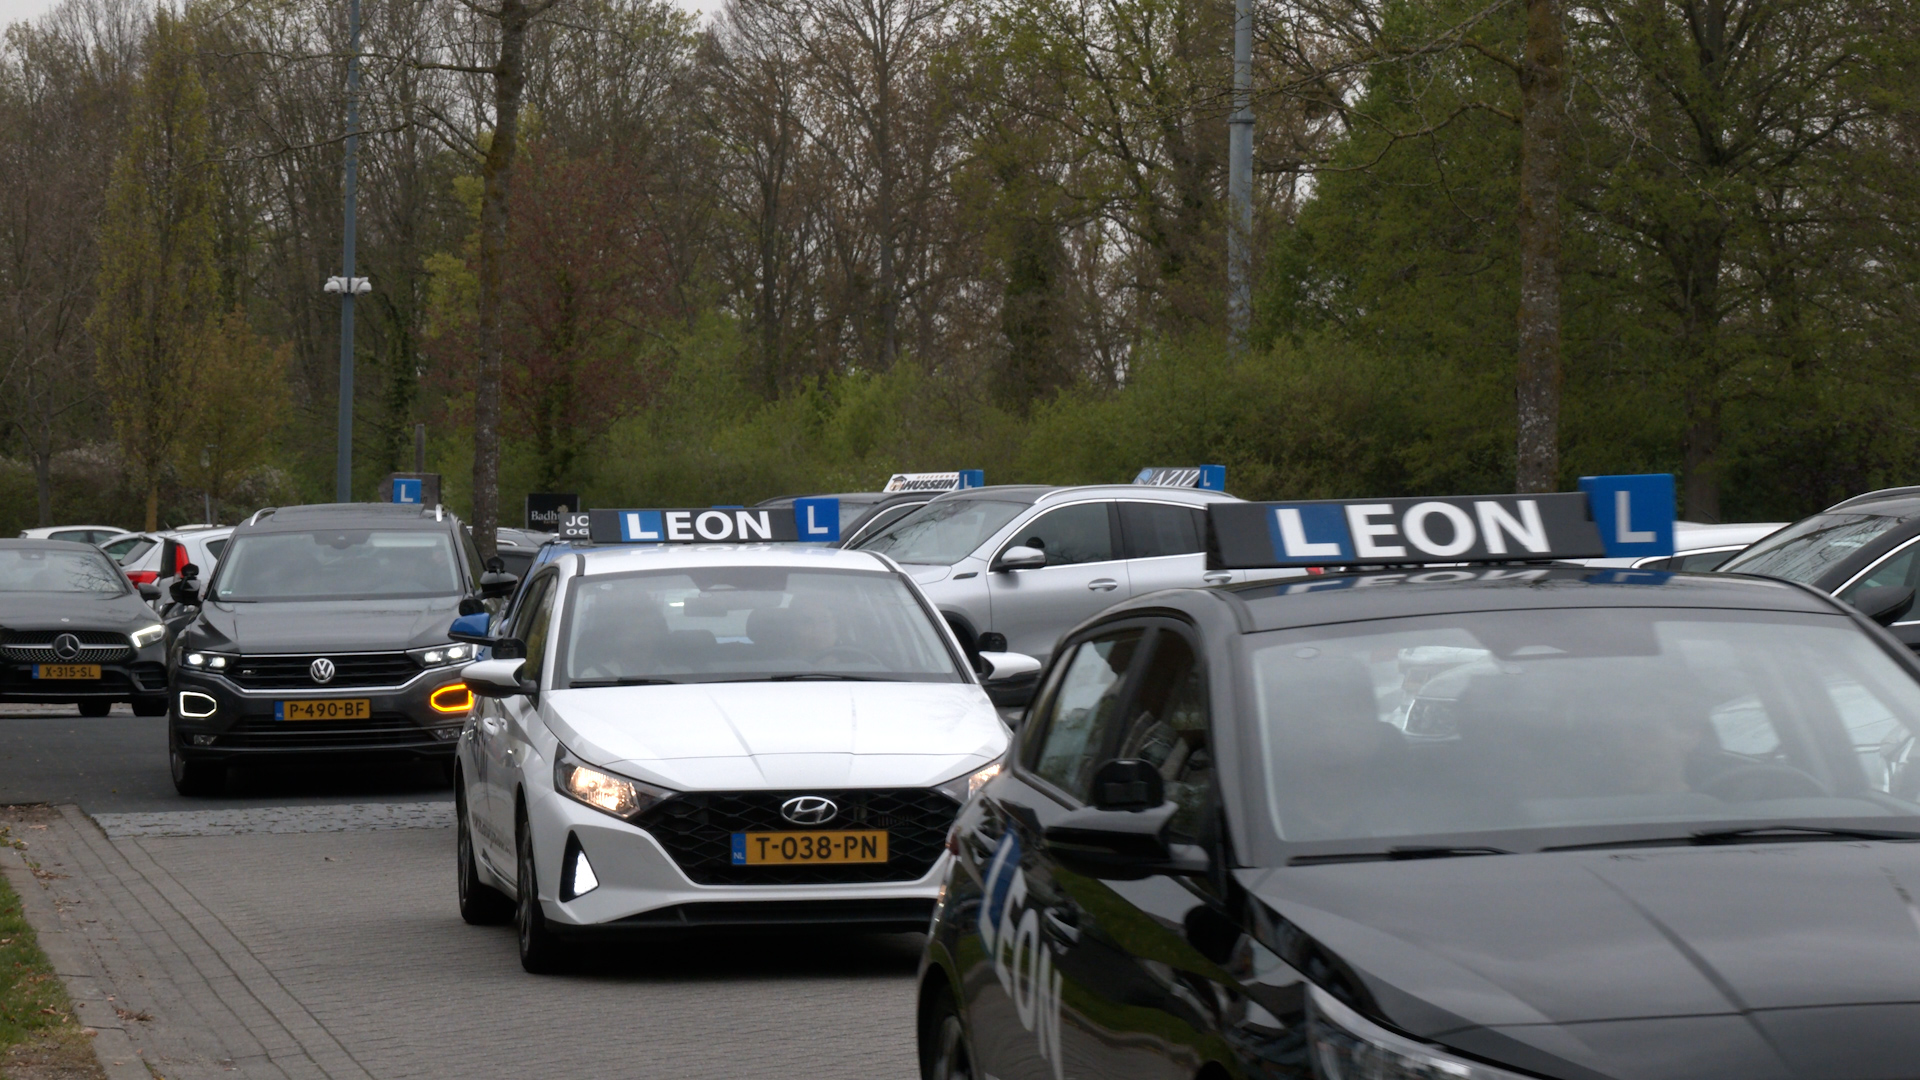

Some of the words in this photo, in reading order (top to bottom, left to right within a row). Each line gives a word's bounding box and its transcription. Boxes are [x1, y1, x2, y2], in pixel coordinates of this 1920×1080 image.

[902, 479, 958, 491] HUSSEIN
[1149, 469, 1200, 487] AZIZ
[1203, 470, 1211, 487] L
[400, 483, 414, 503] L
[626, 510, 772, 540] LEON
[807, 505, 829, 534] L
[1615, 490, 1657, 544] L
[1275, 499, 1552, 559] LEON
[45, 666, 95, 678] X-315-SL
[289, 702, 365, 718] P-490-BF
[733, 852, 745, 860] NL
[755, 835, 878, 861] T-038-PN
